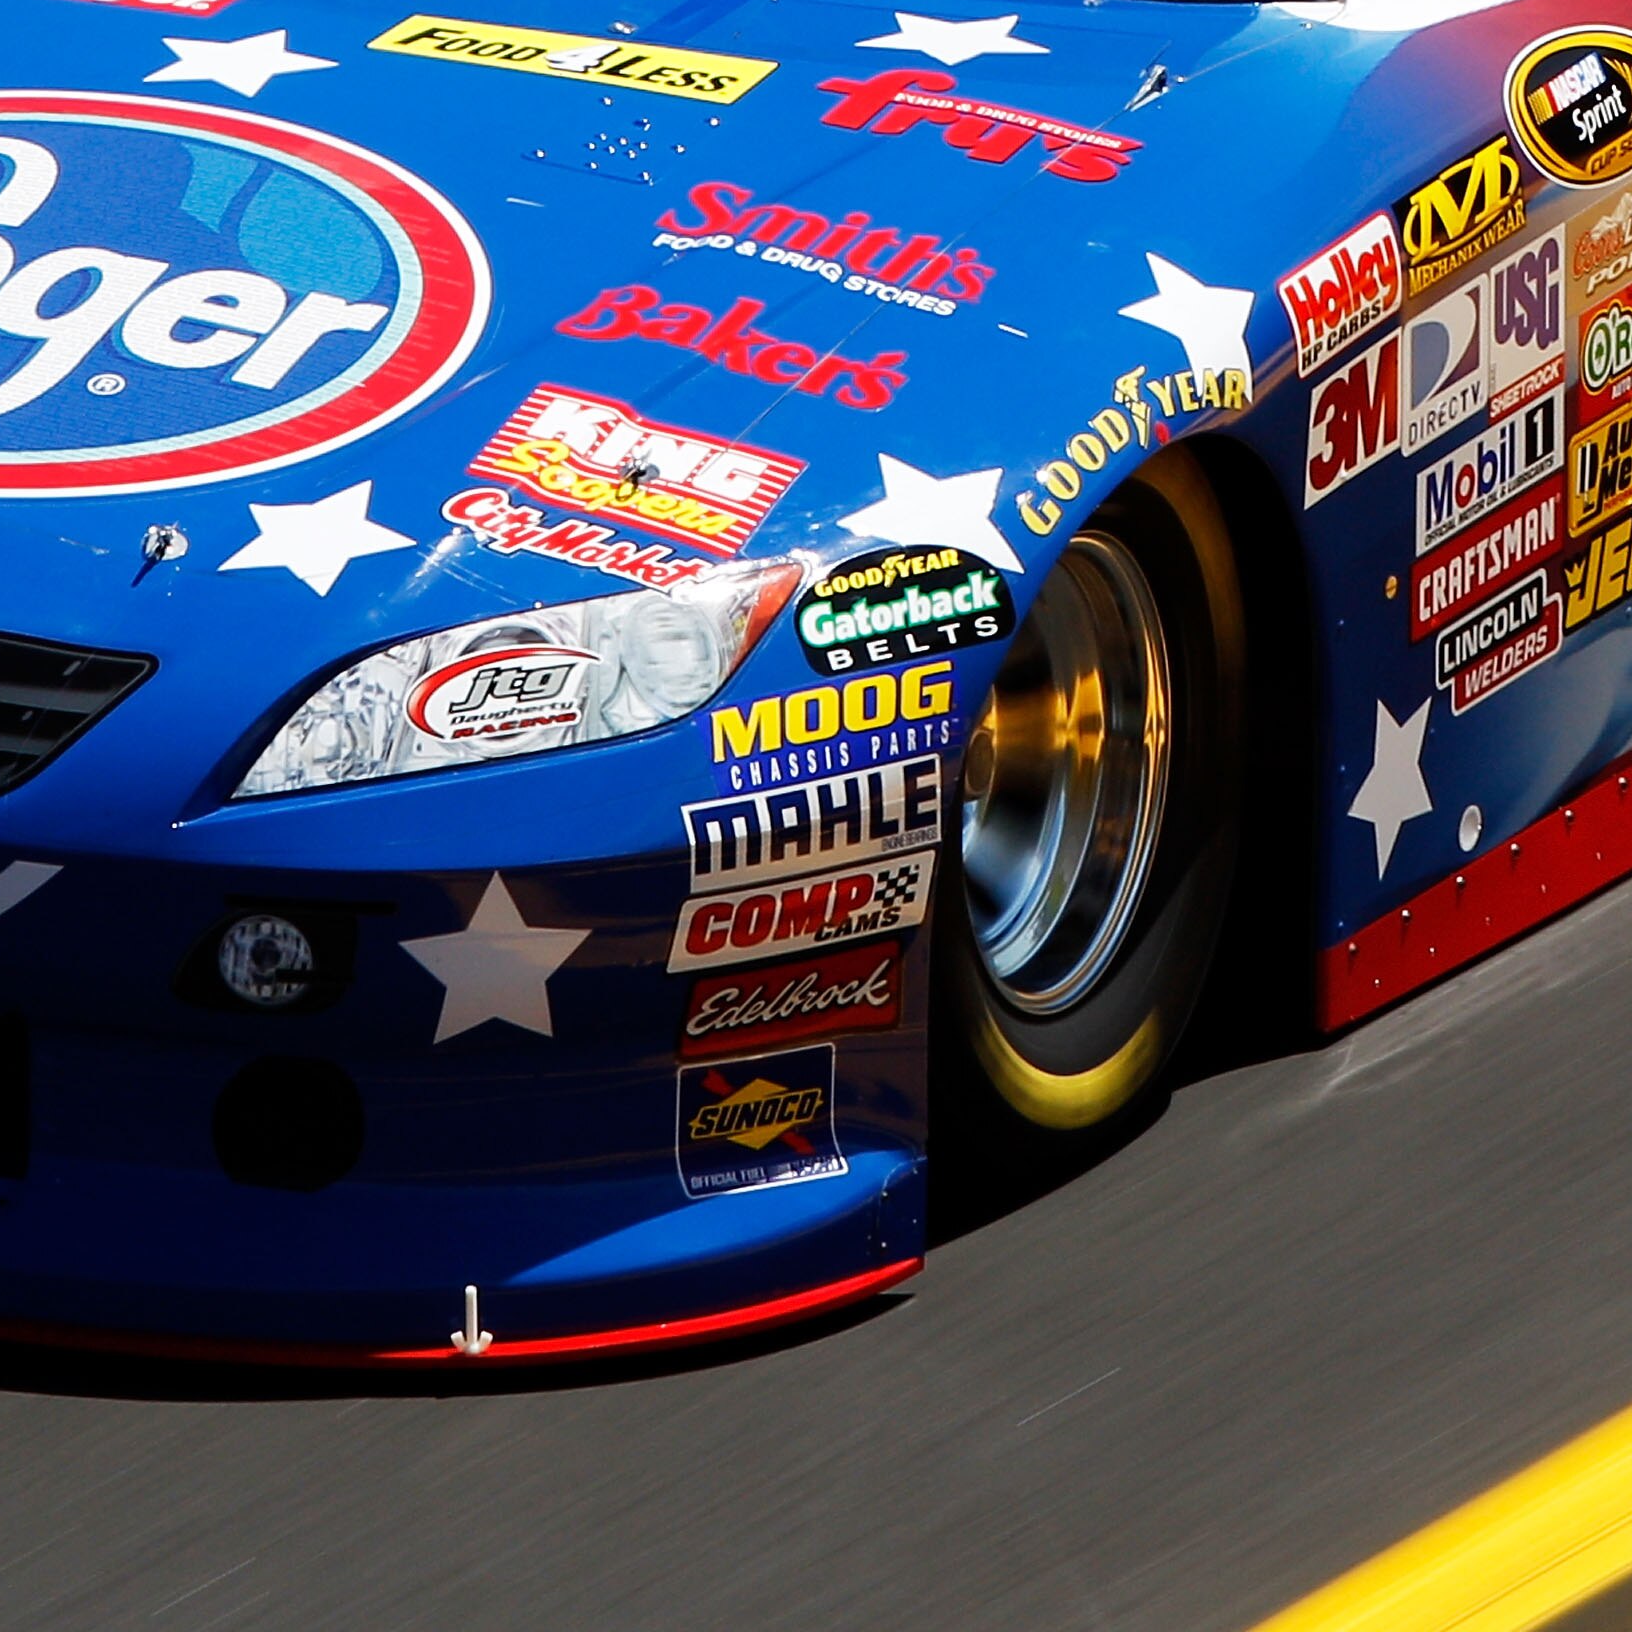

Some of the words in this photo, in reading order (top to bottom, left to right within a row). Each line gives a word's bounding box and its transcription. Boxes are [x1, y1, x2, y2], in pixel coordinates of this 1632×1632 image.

[544, 43, 622, 75] 4
[1548, 51, 1607, 113] NASCAR
[894, 91, 955, 111] FOOD
[956, 101, 973, 112] &
[976, 104, 1037, 128] DRUG
[1572, 84, 1627, 144] Sprint
[1590, 148, 1618, 176] CUP
[652, 231, 733, 252] FOOD
[734, 240, 758, 258] &
[760, 246, 844, 285] DRUG
[843, 272, 959, 317] STORES
[654, 180, 997, 304] Smith's
[1408, 232, 1483, 299] MECHANIX
[1483, 198, 1527, 249] WEAR
[1284, 233, 1396, 350] Holley
[1494, 236, 1560, 352] USG
[554, 284, 910, 413] Baker's
[1301, 340, 1323, 372] HP
[1325, 298, 1383, 354] CARBS
[1309, 335, 1399, 491] 3M
[1407, 379, 1483, 449] DIRECTV
[1489, 356, 1564, 419] SHEETROCK
[1611, 375, 1632, 400] AUTO
[526, 397, 770, 503] KING
[1425, 421, 1517, 531] Mobil
[1419, 496, 1556, 622] CRAFTSMAN
[797, 570, 1002, 649] Gatorback
[826, 614, 1000, 672] BELTS
[1443, 587, 1539, 673] LINCOLN
[1464, 624, 1549, 698] WELDERS
[449, 700, 575, 727] Daugherty
[450, 711, 579, 741] RACING
[710, 659, 953, 764] MOOG
[729, 740, 852, 792] CHASSIS
[870, 719, 952, 760] PARTS
[687, 756, 939, 878] MAHLE
[683, 872, 875, 958] COMP
[813, 906, 903, 943] CAMS
[685, 958, 893, 1038] Edelbrock
[693, 1090, 821, 1138] SUNOCO
[690, 1169, 738, 1190] OFFICIAL
[740, 1166, 766, 1184] FUEL
